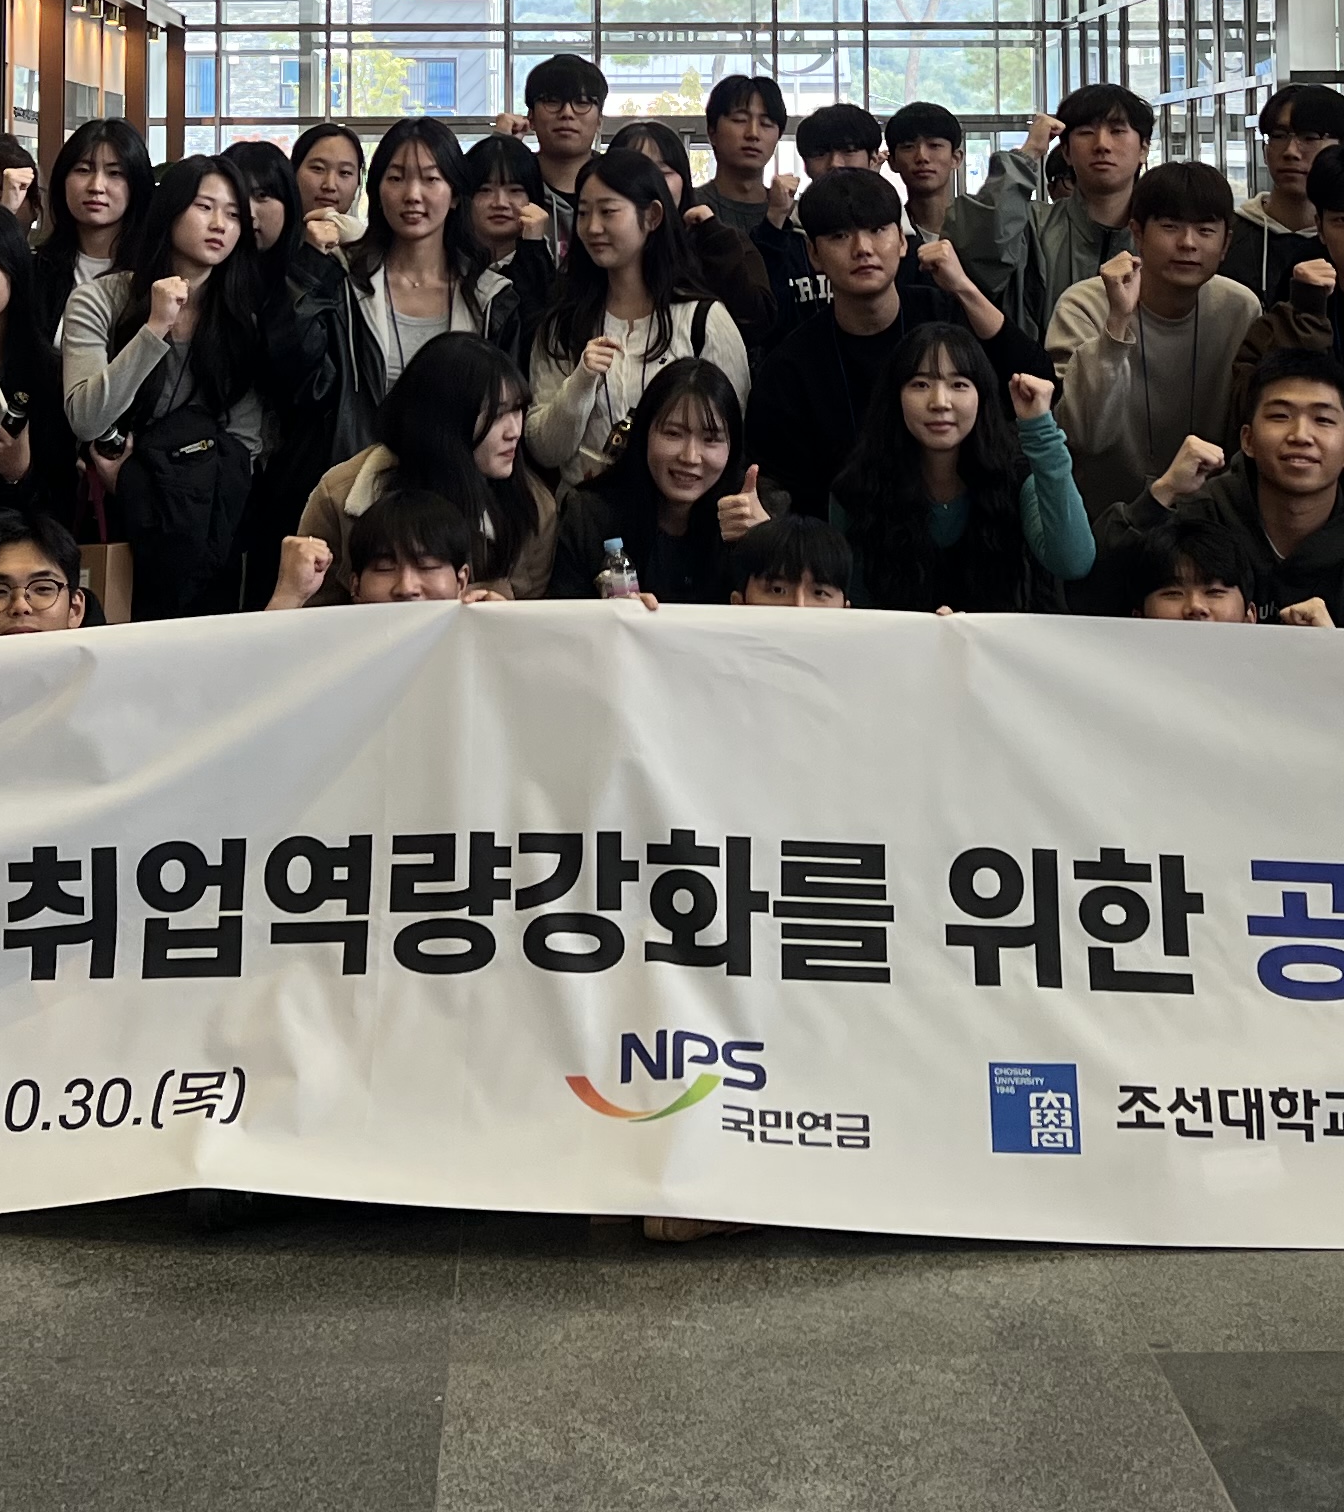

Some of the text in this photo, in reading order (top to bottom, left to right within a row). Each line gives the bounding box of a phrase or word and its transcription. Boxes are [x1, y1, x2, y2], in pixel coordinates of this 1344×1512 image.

[2, 827, 896, 984] 취업역량강화를
[945, 845, 1205, 996] 위한
[619, 1028, 768, 1091] NPS
[993, 1067, 1032, 1077] CHOSUN
[994, 1076, 1045, 1086] UNIVERSITY
[996, 1085, 1016, 1095] 1946
[720, 1104, 872, 1150] 국민연금
